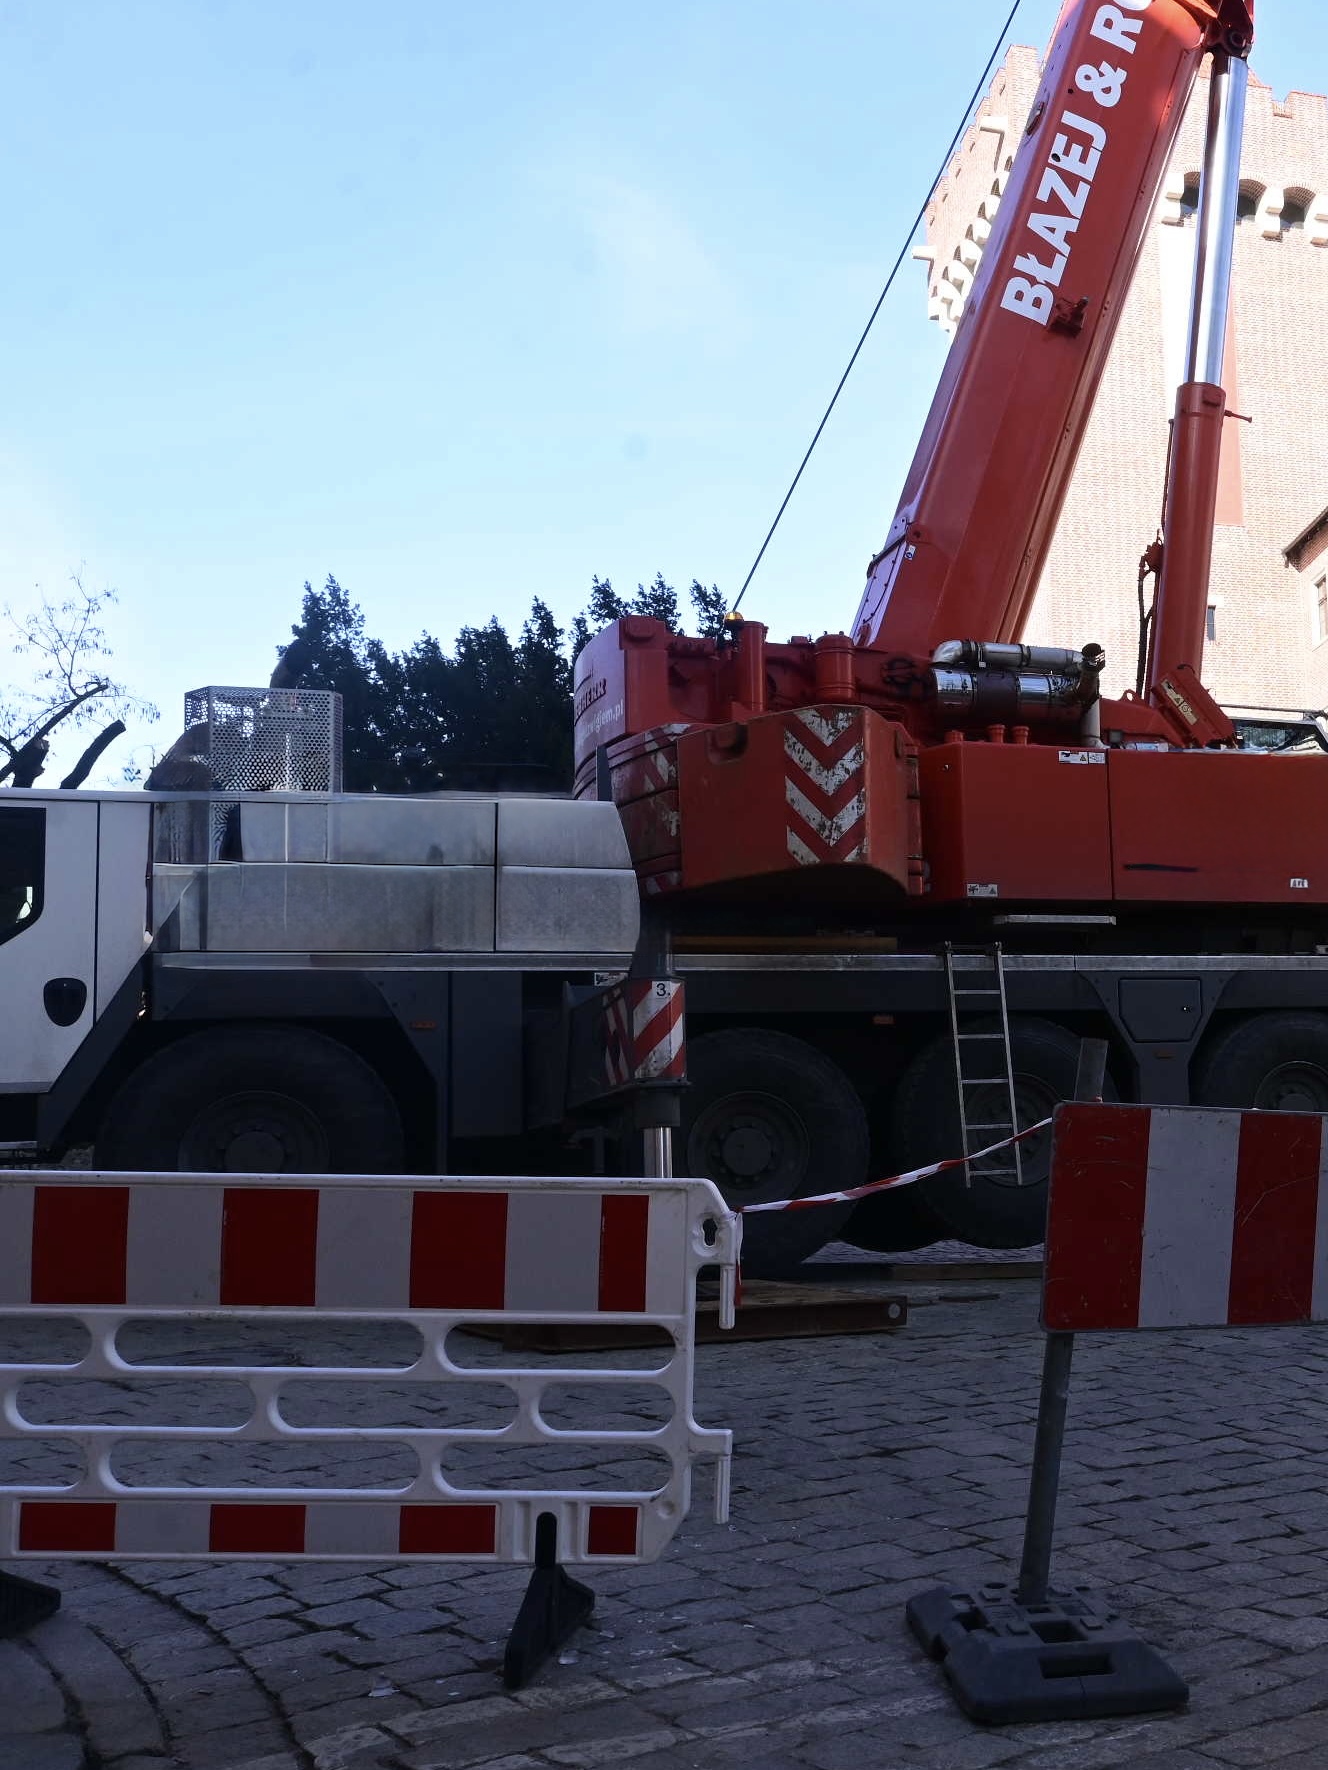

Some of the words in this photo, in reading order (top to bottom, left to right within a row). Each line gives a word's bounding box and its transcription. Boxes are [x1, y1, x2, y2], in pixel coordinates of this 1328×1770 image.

[1000, 110, 1107, 326] BŁAZEJ
[1075, 60, 1127, 108] &
[657, 982, 671, 997] 3.
